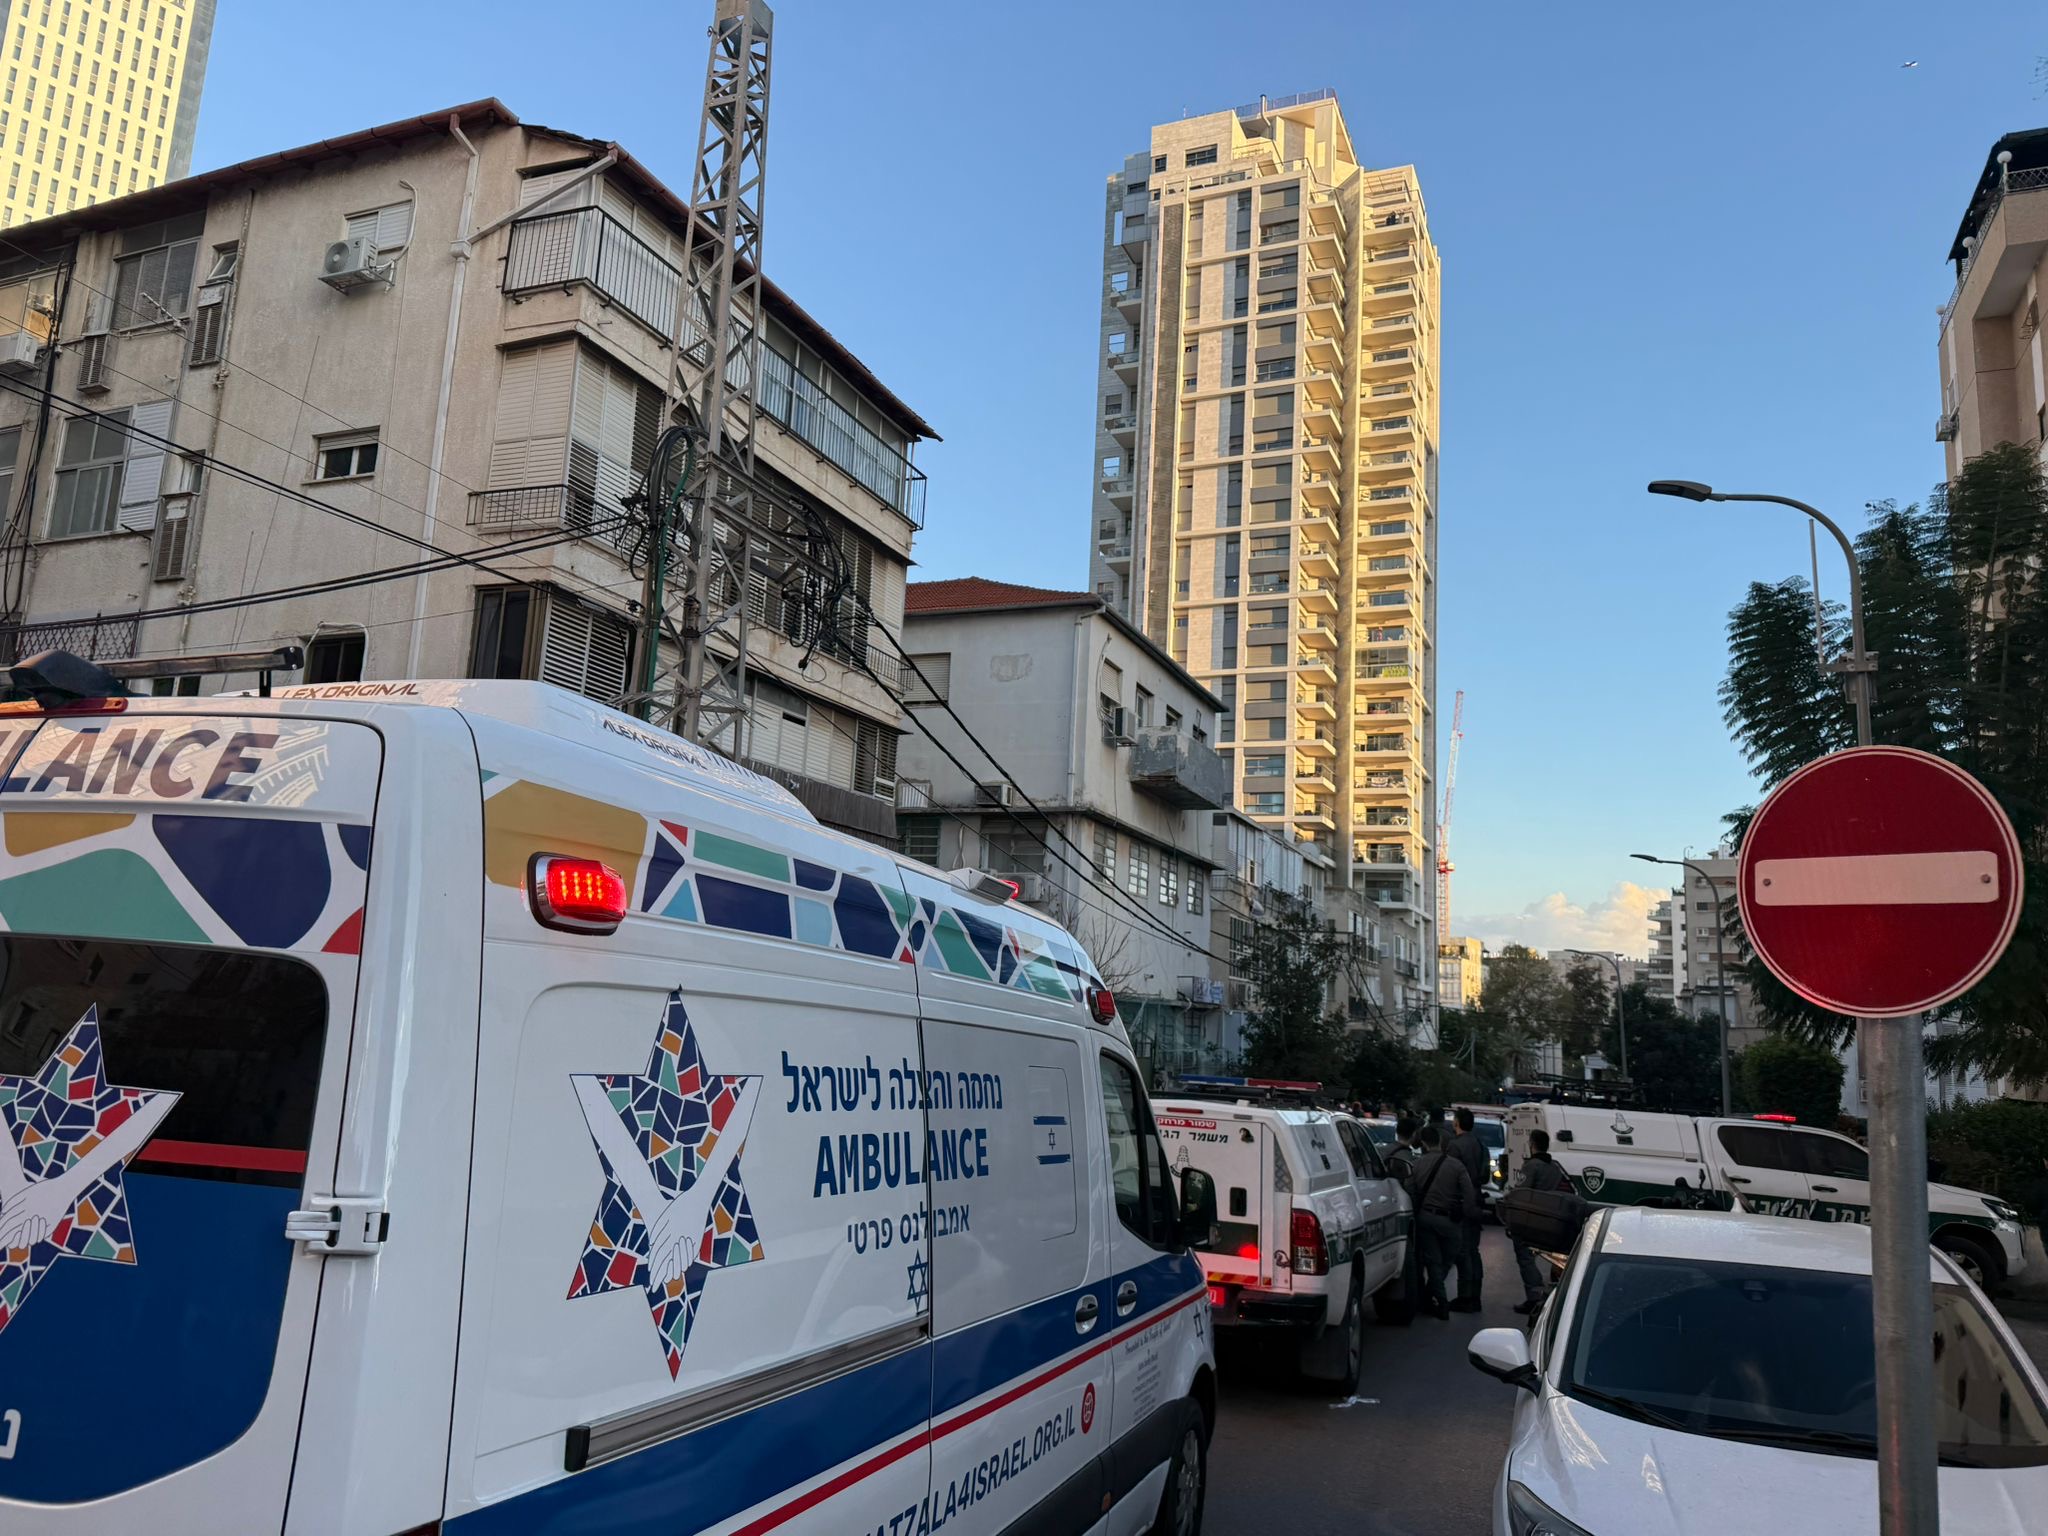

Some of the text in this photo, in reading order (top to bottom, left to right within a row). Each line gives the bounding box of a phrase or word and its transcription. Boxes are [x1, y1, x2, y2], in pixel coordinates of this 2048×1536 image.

[282, 683, 419, 699] LEX ORIGINAL
[0, 726, 280, 802] LANCE
[642, 734, 708, 770] ORIGINAL
[781, 1050, 1003, 1113] נחמה והצלה לישראל
[813, 1128, 989, 1198] AMBULANCE
[1188, 1131, 1229, 1143] משמר
[847, 1201, 970, 1255] אמבולנס פרטי
